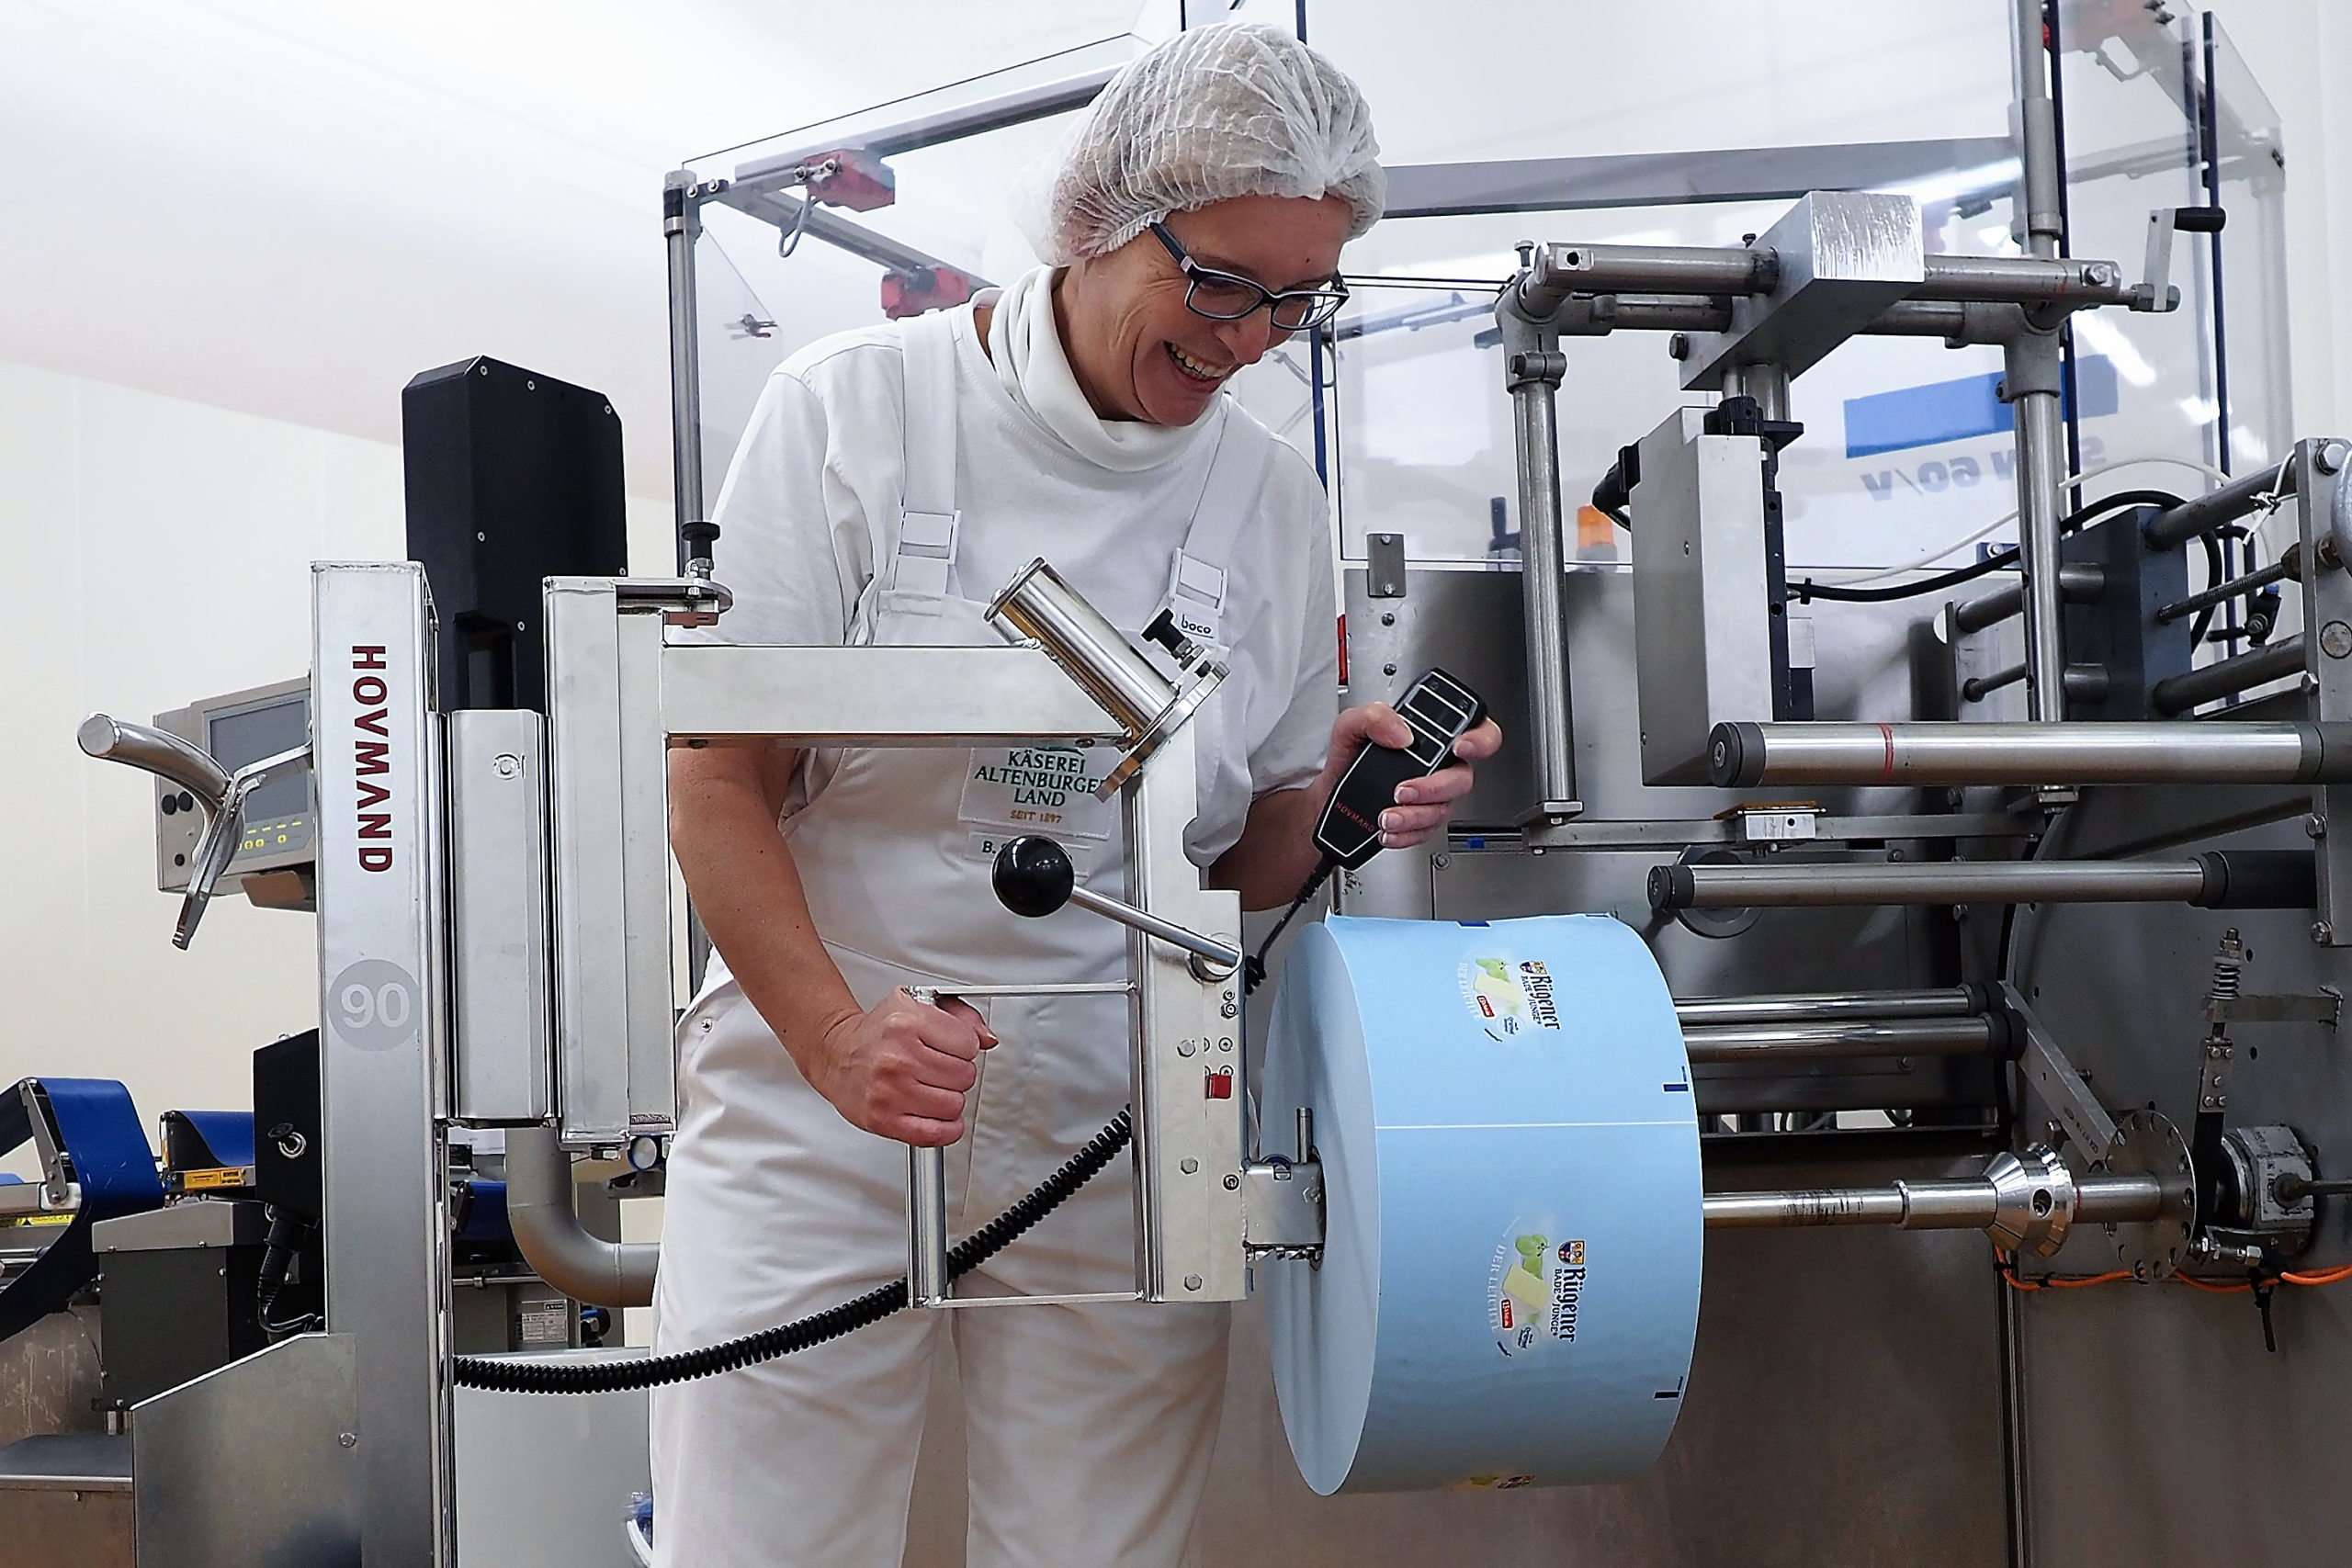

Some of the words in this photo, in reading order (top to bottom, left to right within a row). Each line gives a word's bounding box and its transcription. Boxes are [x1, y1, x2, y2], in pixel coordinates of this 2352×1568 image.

[1181, 614, 1212, 634] boco
[351, 645, 393, 873] HOVMAND
[1008, 750, 1086, 774] KÄSEREI
[975, 766, 1106, 794] ALTENBURGE
[1013, 788, 1066, 807] LAND
[1010, 810, 1035, 822] SEIT
[1335, 802, 1375, 833] HOVMAND
[341, 983, 411, 1028] 90
[1530, 975, 1560, 1030] Rügener
[1490, 1245, 1506, 1272] DER
[1553, 1269, 1563, 1293] BADE
[1556, 1267, 1587, 1343] Rügener
